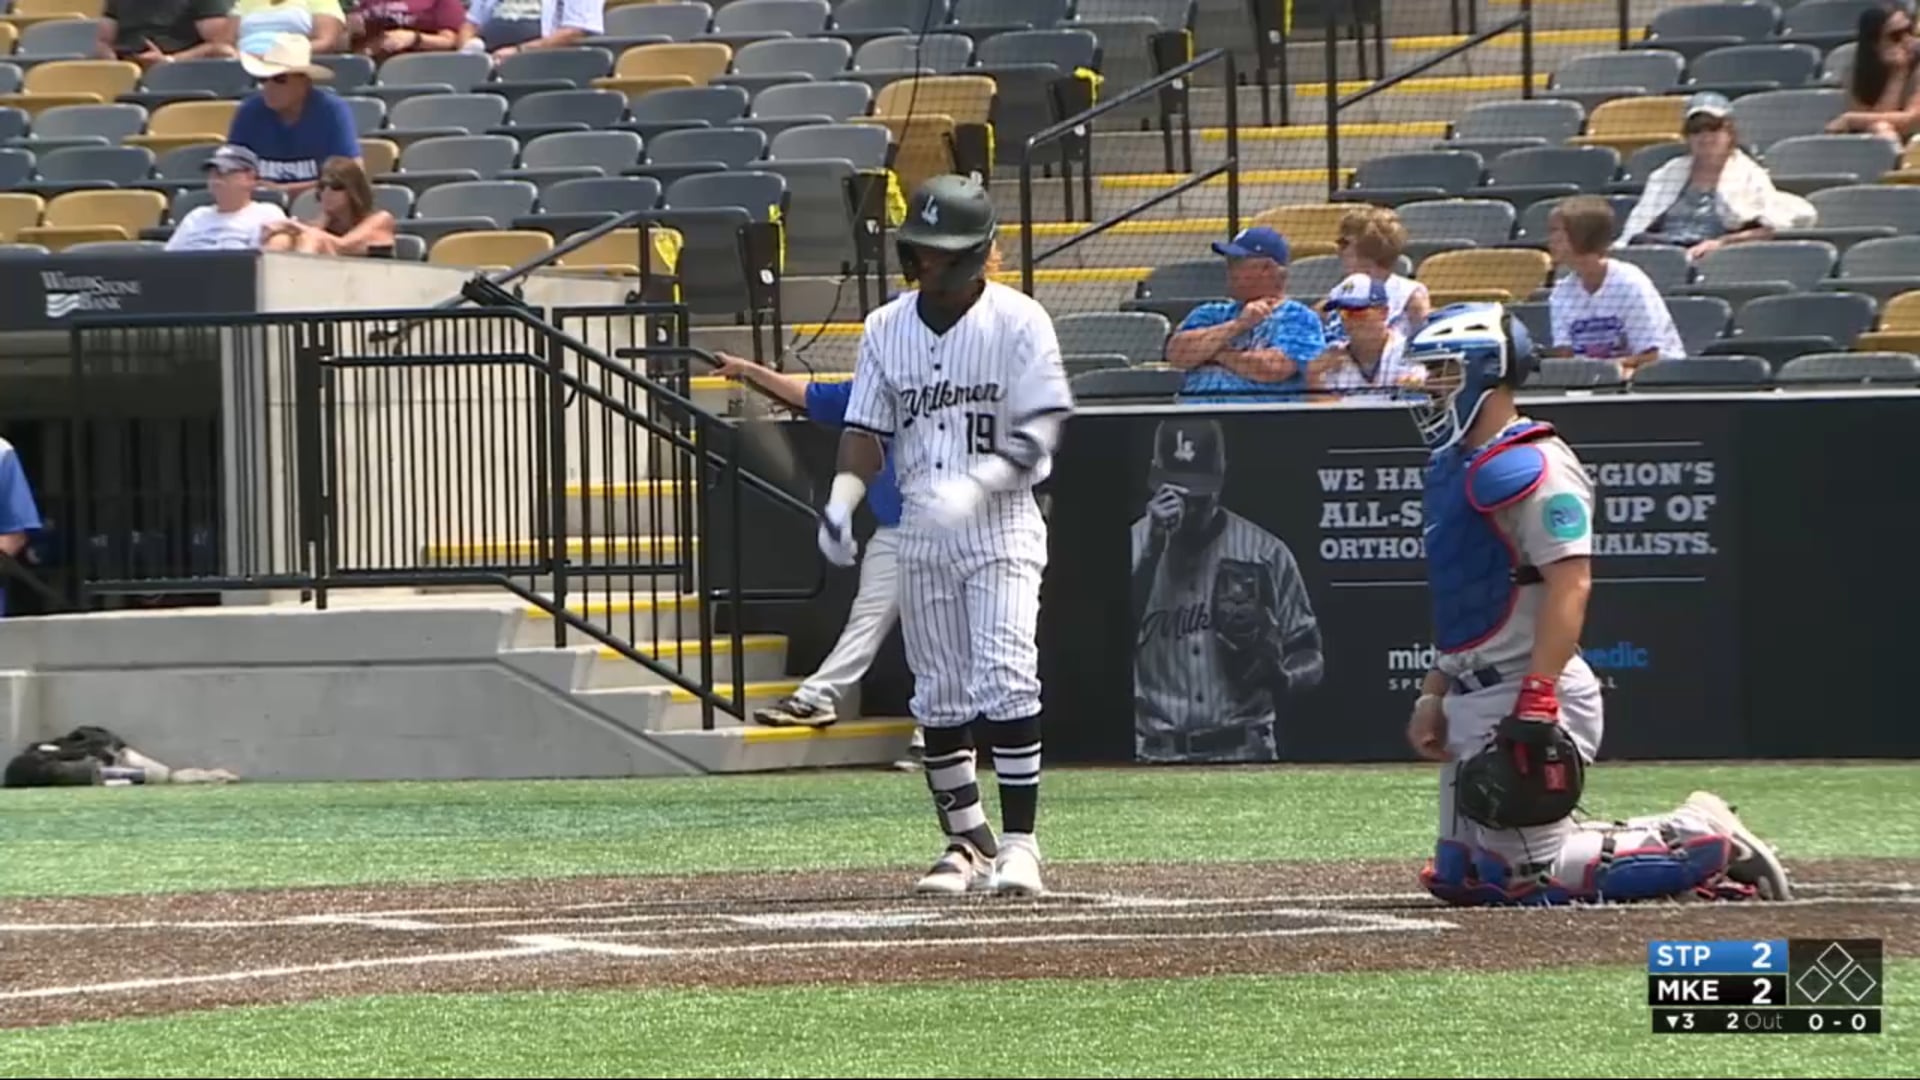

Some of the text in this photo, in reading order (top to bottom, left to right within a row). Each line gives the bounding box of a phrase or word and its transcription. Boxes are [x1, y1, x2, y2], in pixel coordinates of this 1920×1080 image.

[965, 411, 996, 454] 19
[1317, 462, 1715, 491] WE HA EGION'S
[1319, 500, 1423, 528] ALL-S
[1604, 496, 1655, 523] UP
[1666, 494, 1716, 522] OF
[1320, 537, 1427, 560] ORTHO
[1139, 602, 1211, 647] Milk
